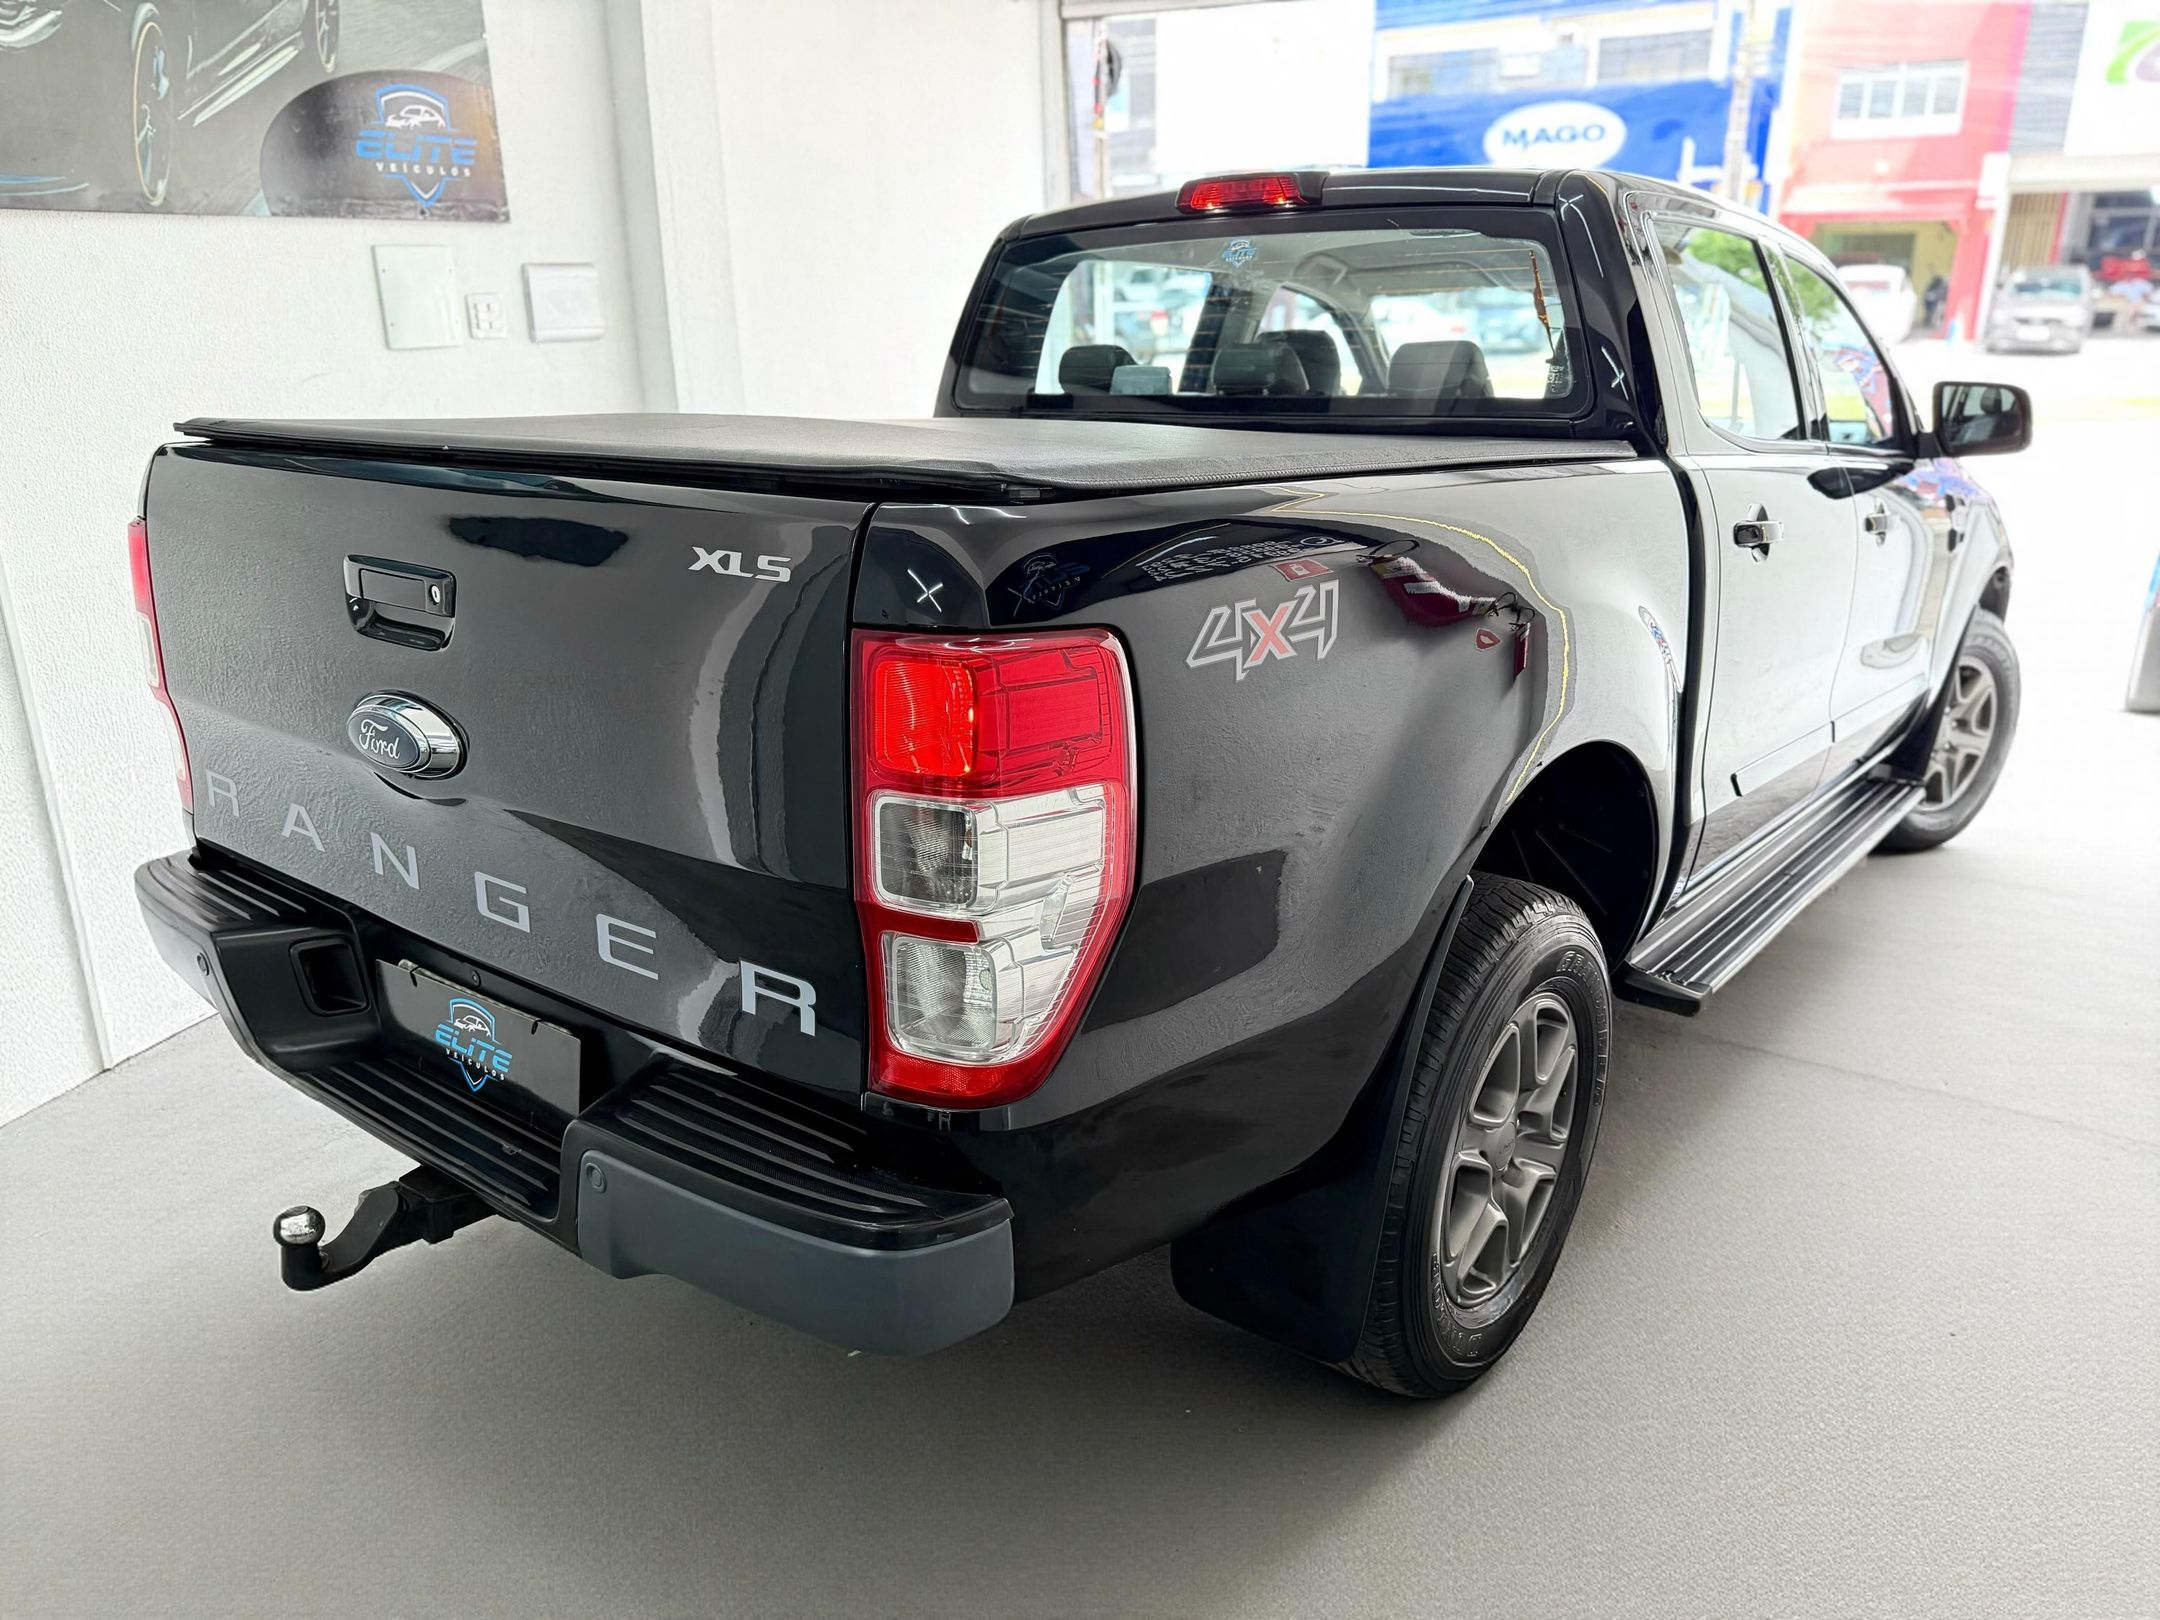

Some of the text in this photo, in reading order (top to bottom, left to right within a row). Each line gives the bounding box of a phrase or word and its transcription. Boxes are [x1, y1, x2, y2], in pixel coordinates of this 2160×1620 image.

[356, 129, 477, 167] ELITE
[1503, 123, 1606, 147] MAGO
[688, 546, 791, 582] XLS
[359, 719, 401, 759] Ford
[205, 770, 817, 1037] RANGER
[435, 1023, 513, 1073] ELITE
